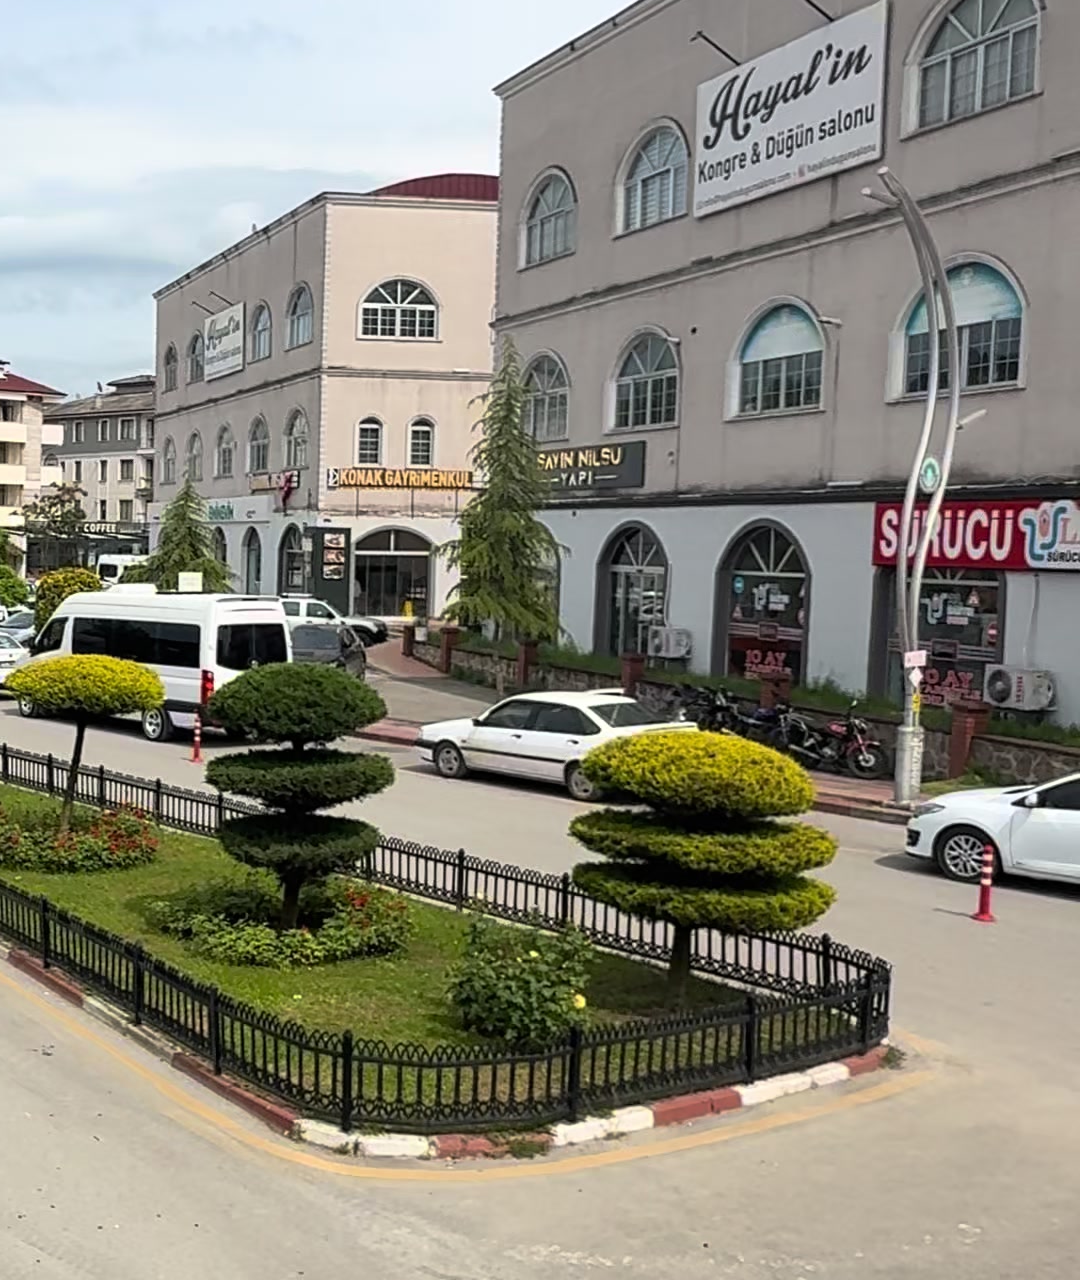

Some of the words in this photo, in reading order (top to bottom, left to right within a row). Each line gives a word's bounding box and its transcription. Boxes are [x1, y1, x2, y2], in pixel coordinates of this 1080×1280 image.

[703, 43, 873, 150] Hayal'in
[698, 151, 747, 184] Kongre
[751, 142, 761, 165] &
[765, 123, 814, 159] Düğün
[818, 103, 875, 141] salonu
[340, 470, 383, 485] KONAK
[385, 470, 473, 487] GAYRİMENKUL
[561, 471, 592, 486] YAPI
[83, 523, 117, 533] COFFEE
[764, 651, 787, 667] AY
[941, 670, 974, 688] AY
